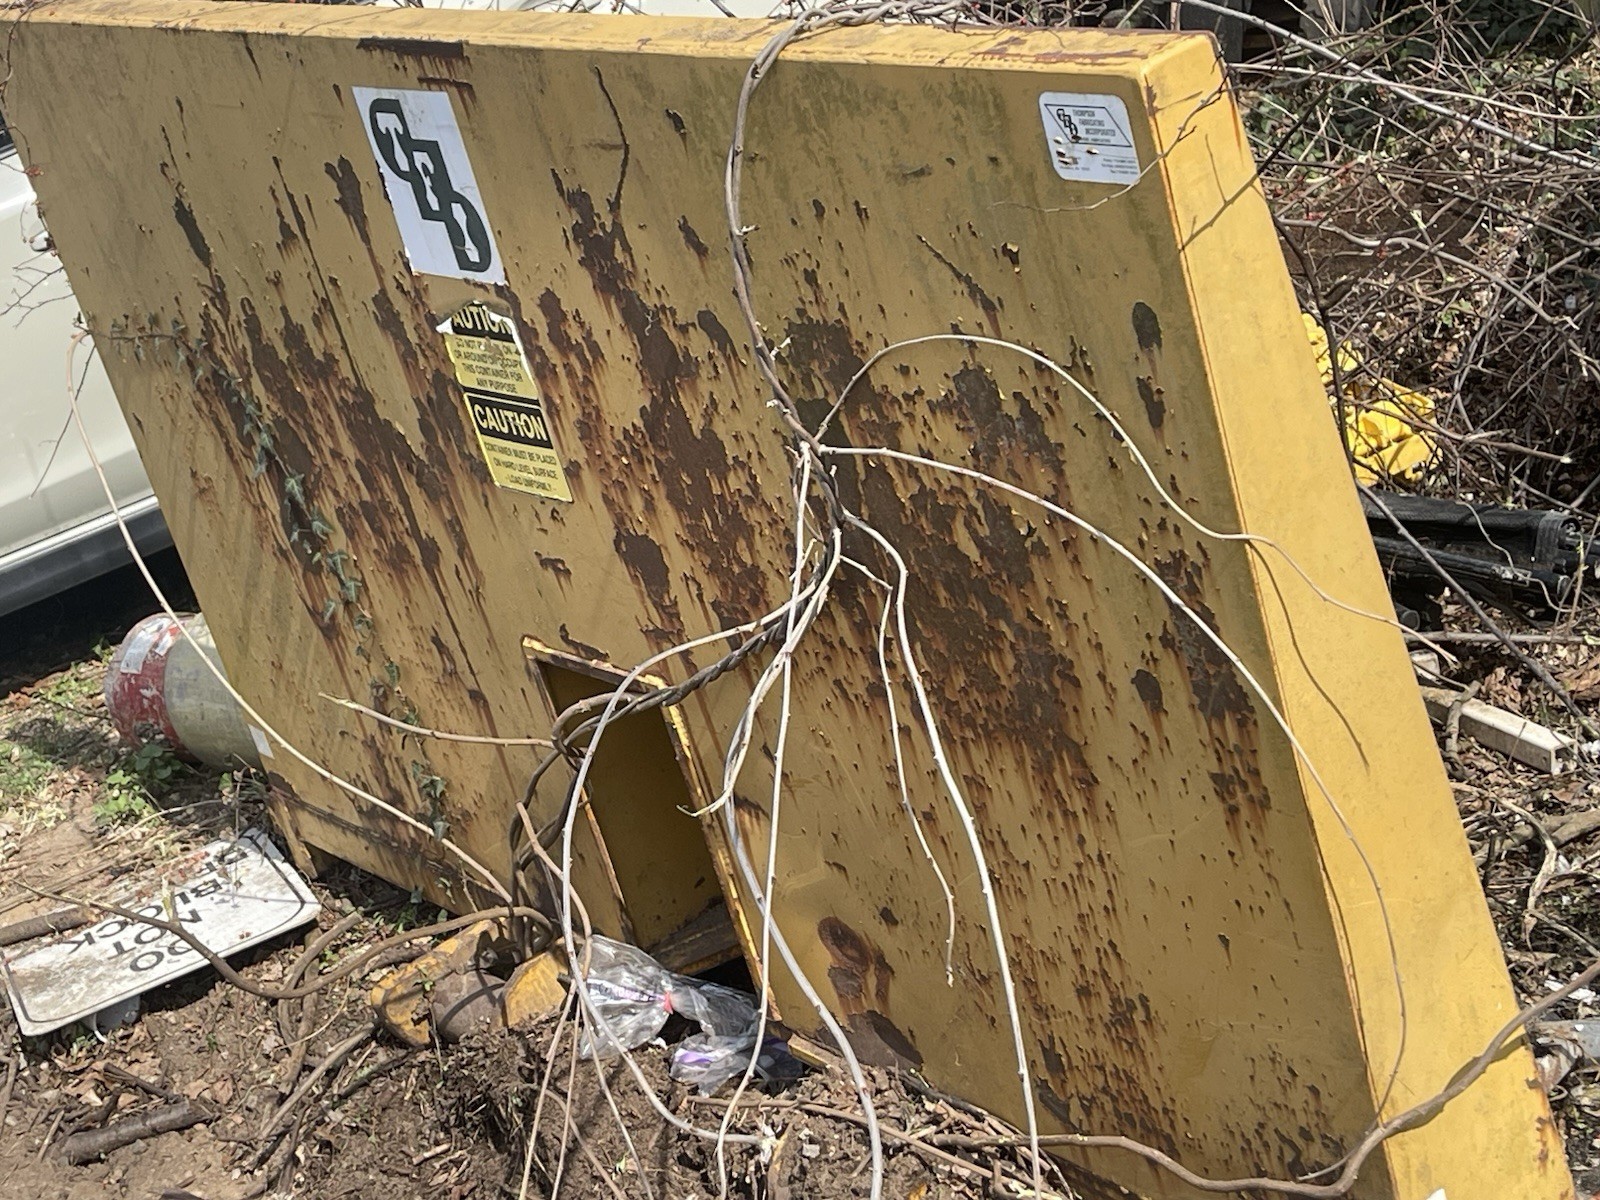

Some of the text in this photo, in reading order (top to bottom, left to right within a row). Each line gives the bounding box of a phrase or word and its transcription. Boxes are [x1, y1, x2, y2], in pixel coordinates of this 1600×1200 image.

[451, 306, 512, 335] AUTION
[475, 365, 510, 380] CONTAINER
[510, 371, 524, 382] FOR
[476, 378, 518, 394] ANY PURPOSE
[474, 404, 548, 441] CAUTION
[484, 442, 556, 466] CONTAINER MUST BE PLACED
[493, 457, 502, 466] ON
[517, 463, 534, 475] LEVEL
[533, 466, 558, 480] SURFACE
[62, 878, 222, 954] BLOCK
[106, 908, 202, 960] NOT
[129, 934, 196, 972] DO
